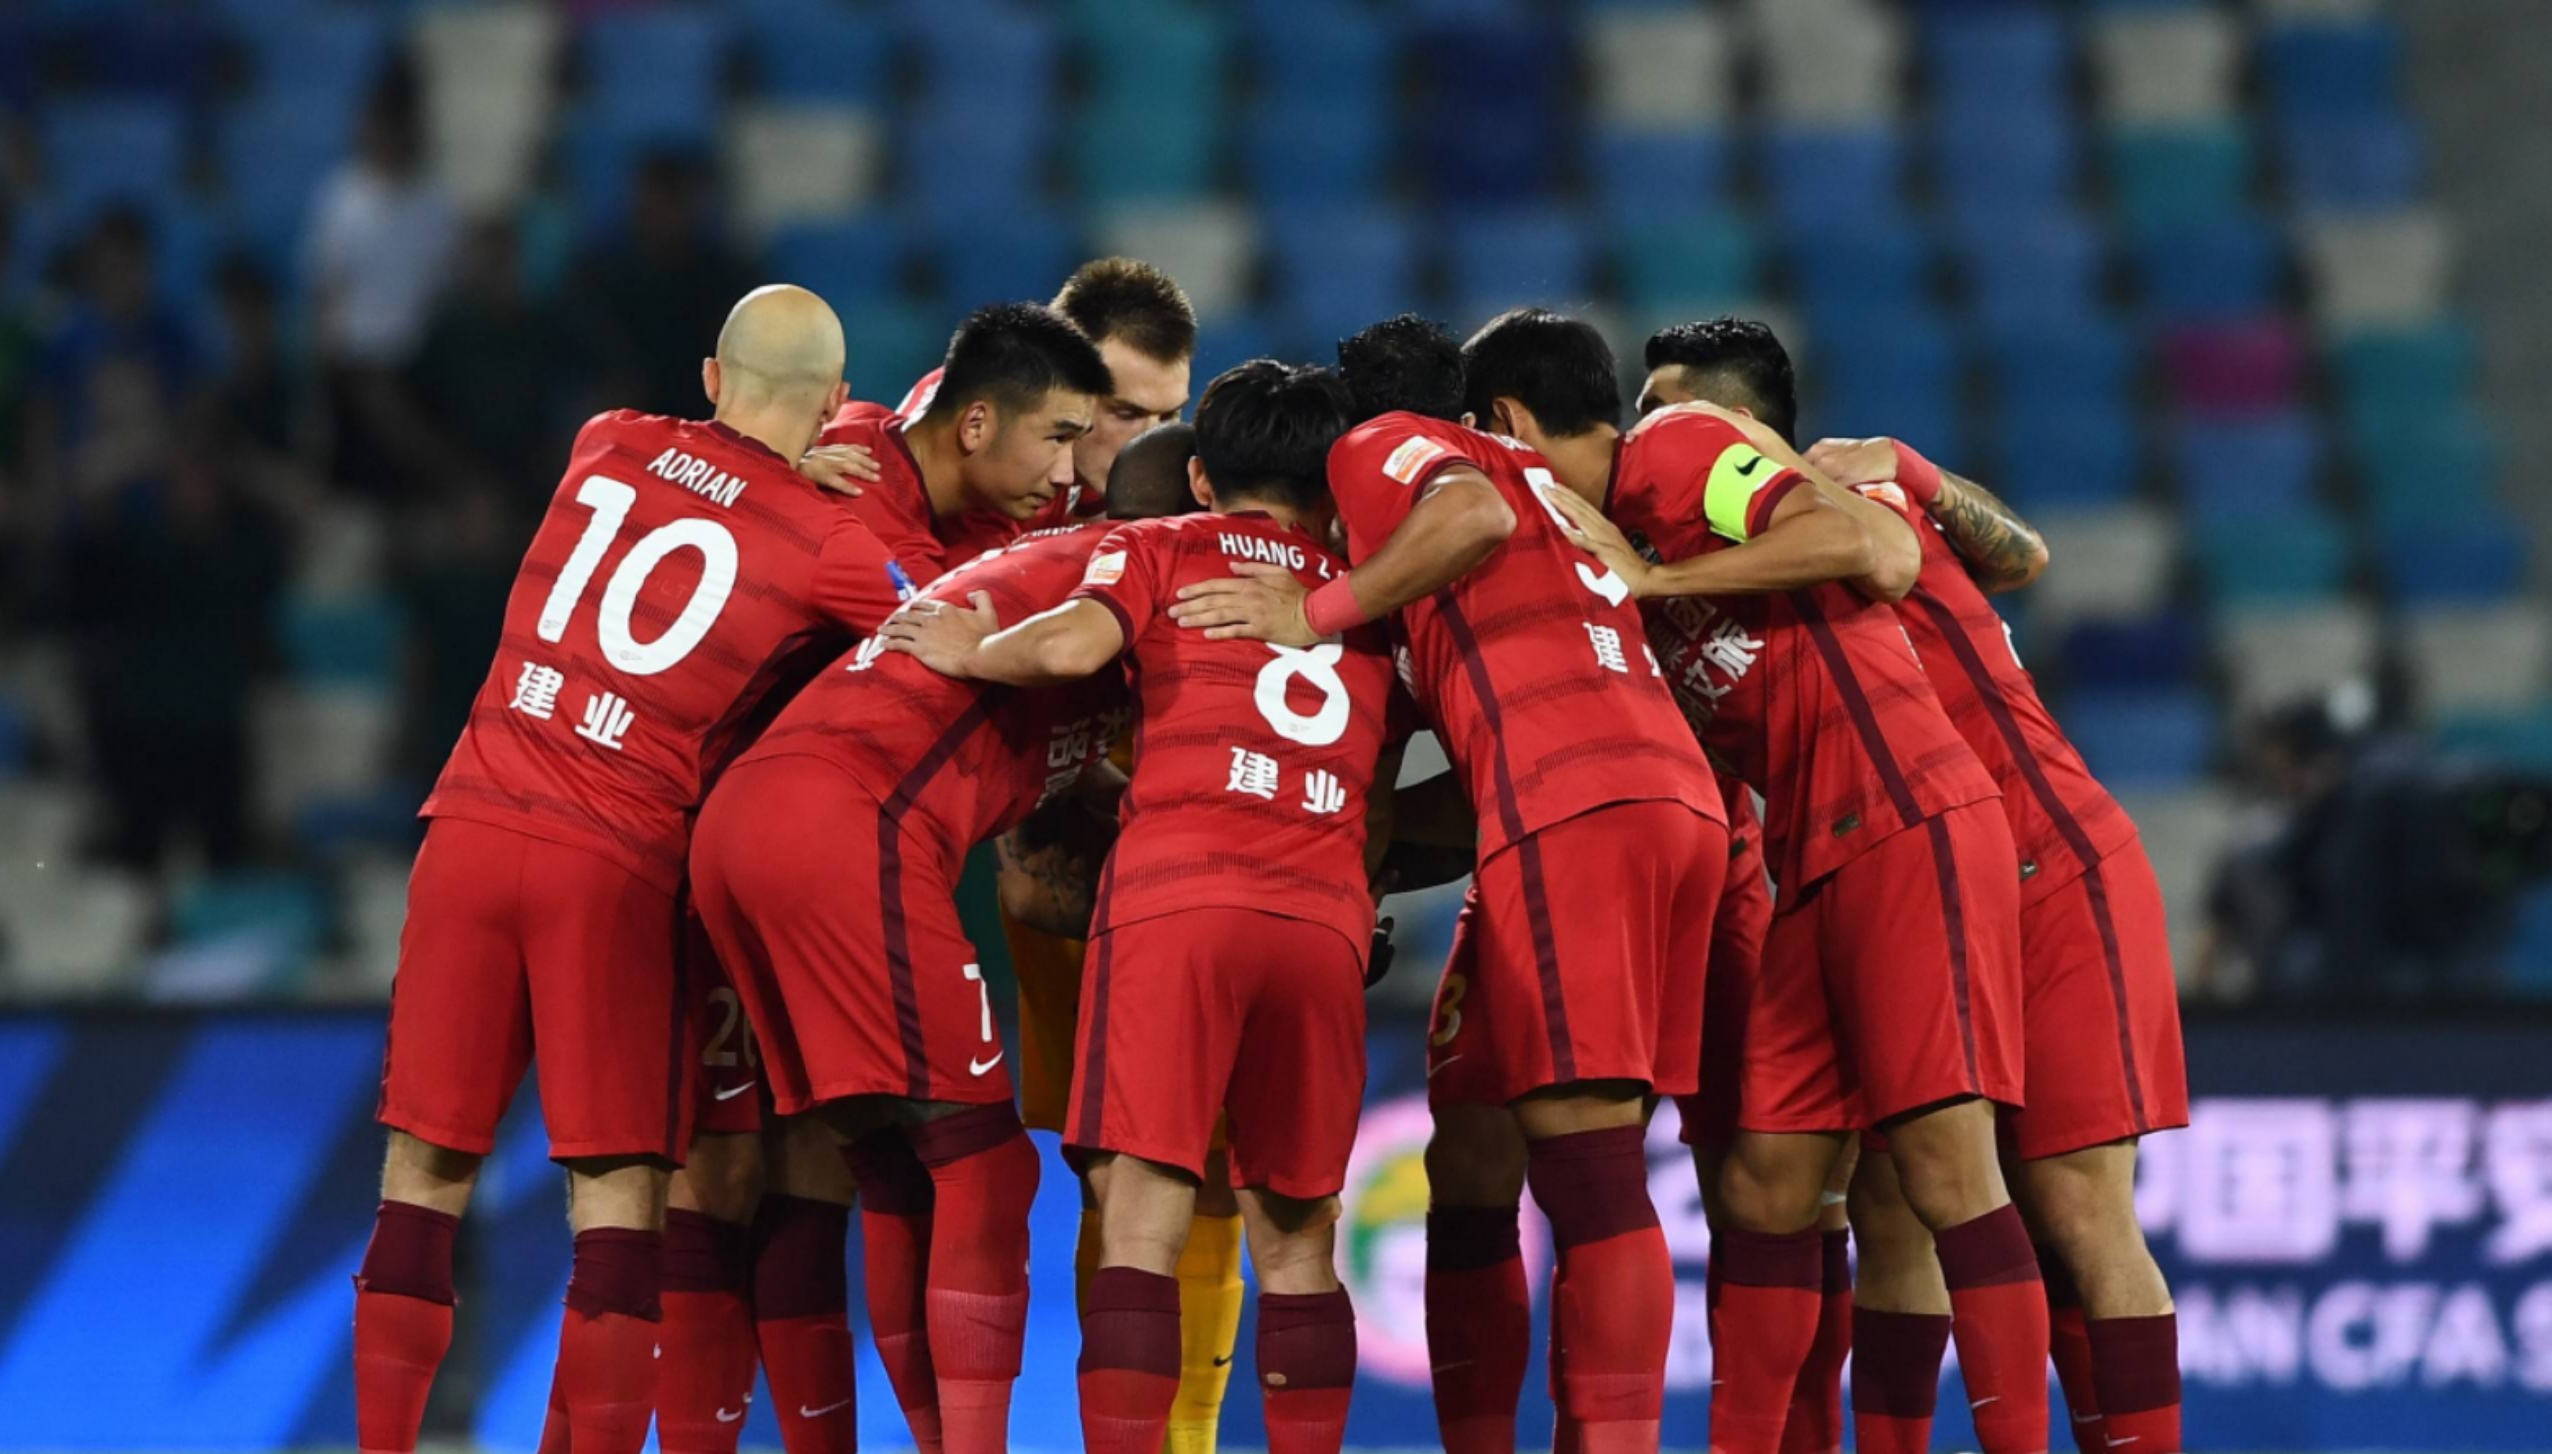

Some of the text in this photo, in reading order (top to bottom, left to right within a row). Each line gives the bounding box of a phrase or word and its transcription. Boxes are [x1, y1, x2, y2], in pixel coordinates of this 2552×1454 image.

[646, 447, 746, 509] ADRIAN
[537, 474, 740, 676] 10
[1218, 532, 1305, 571] HUANG
[508, 660, 636, 751] 建业
[1254, 632, 1351, 747] 8
[1225, 745, 1347, 815] 建业
[962, 963, 993, 1043] 7
